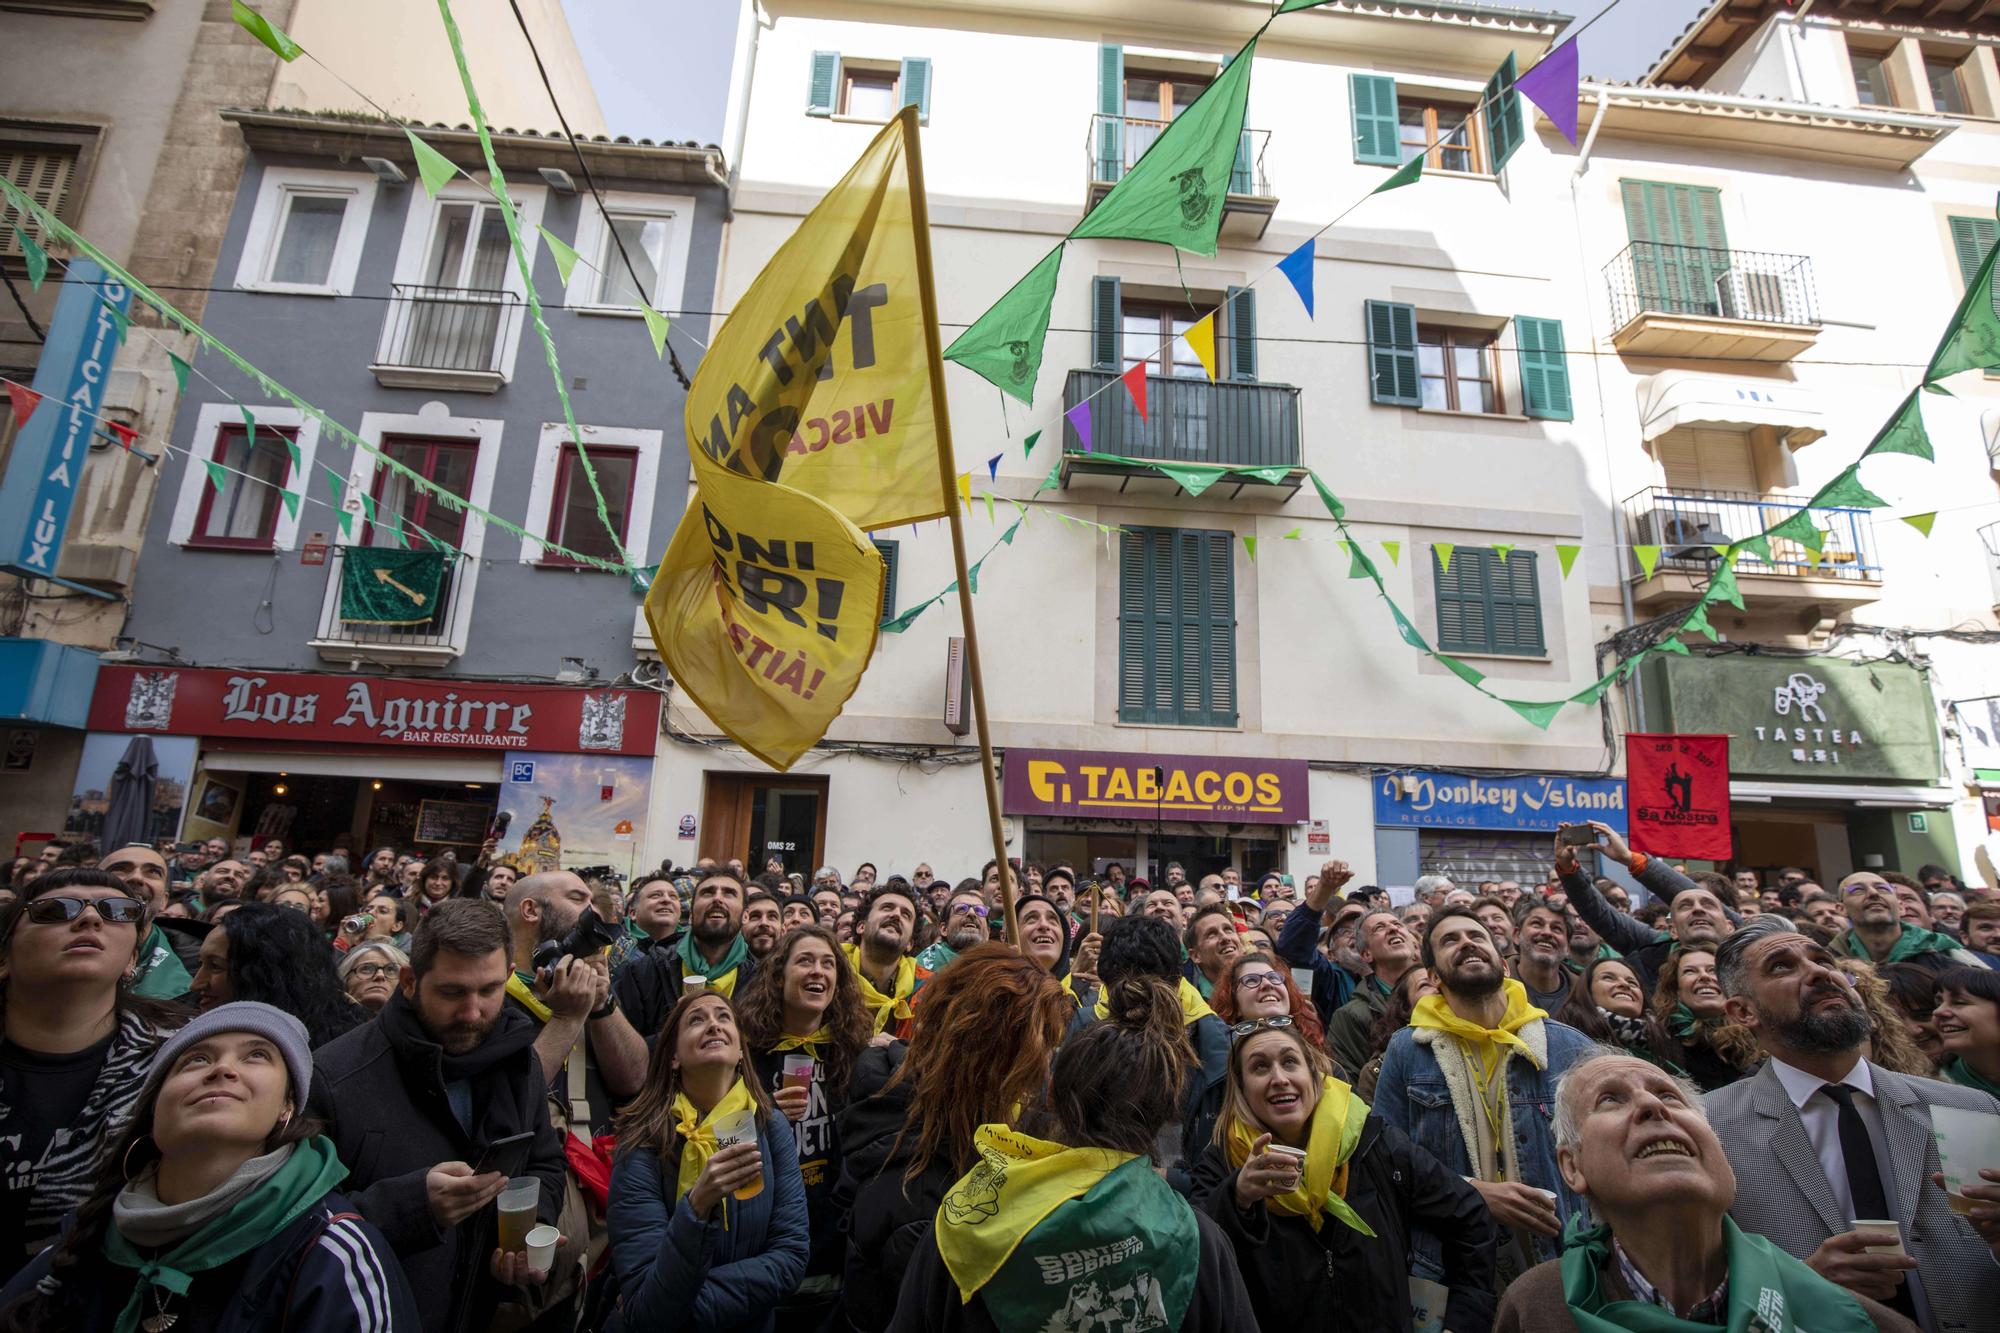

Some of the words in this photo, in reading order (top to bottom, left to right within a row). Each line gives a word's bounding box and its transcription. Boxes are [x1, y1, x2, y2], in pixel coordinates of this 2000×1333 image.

[26, 499, 57, 568] LUX
[222, 676, 320, 725] Los
[332, 681, 532, 739] Aguirre
[403, 731, 429, 743] BAR
[433, 732, 528, 747] RESTAURANTE
[1755, 726, 1863, 745] TASTEA
[514, 764, 532, 777] BC
[1079, 765, 1282, 806] TABACOS
[1383, 775, 1518, 814] Monkey
[1522, 778, 1625, 811] Island
[1401, 814, 1477, 825] REGALOS
[1637, 807, 1660, 821] Sa
[767, 841, 784, 850] OMS
[785, 842, 796, 851] 22
[1035, 1245, 1112, 1270] SANT
[1110, 1235, 1140, 1252] 2023
